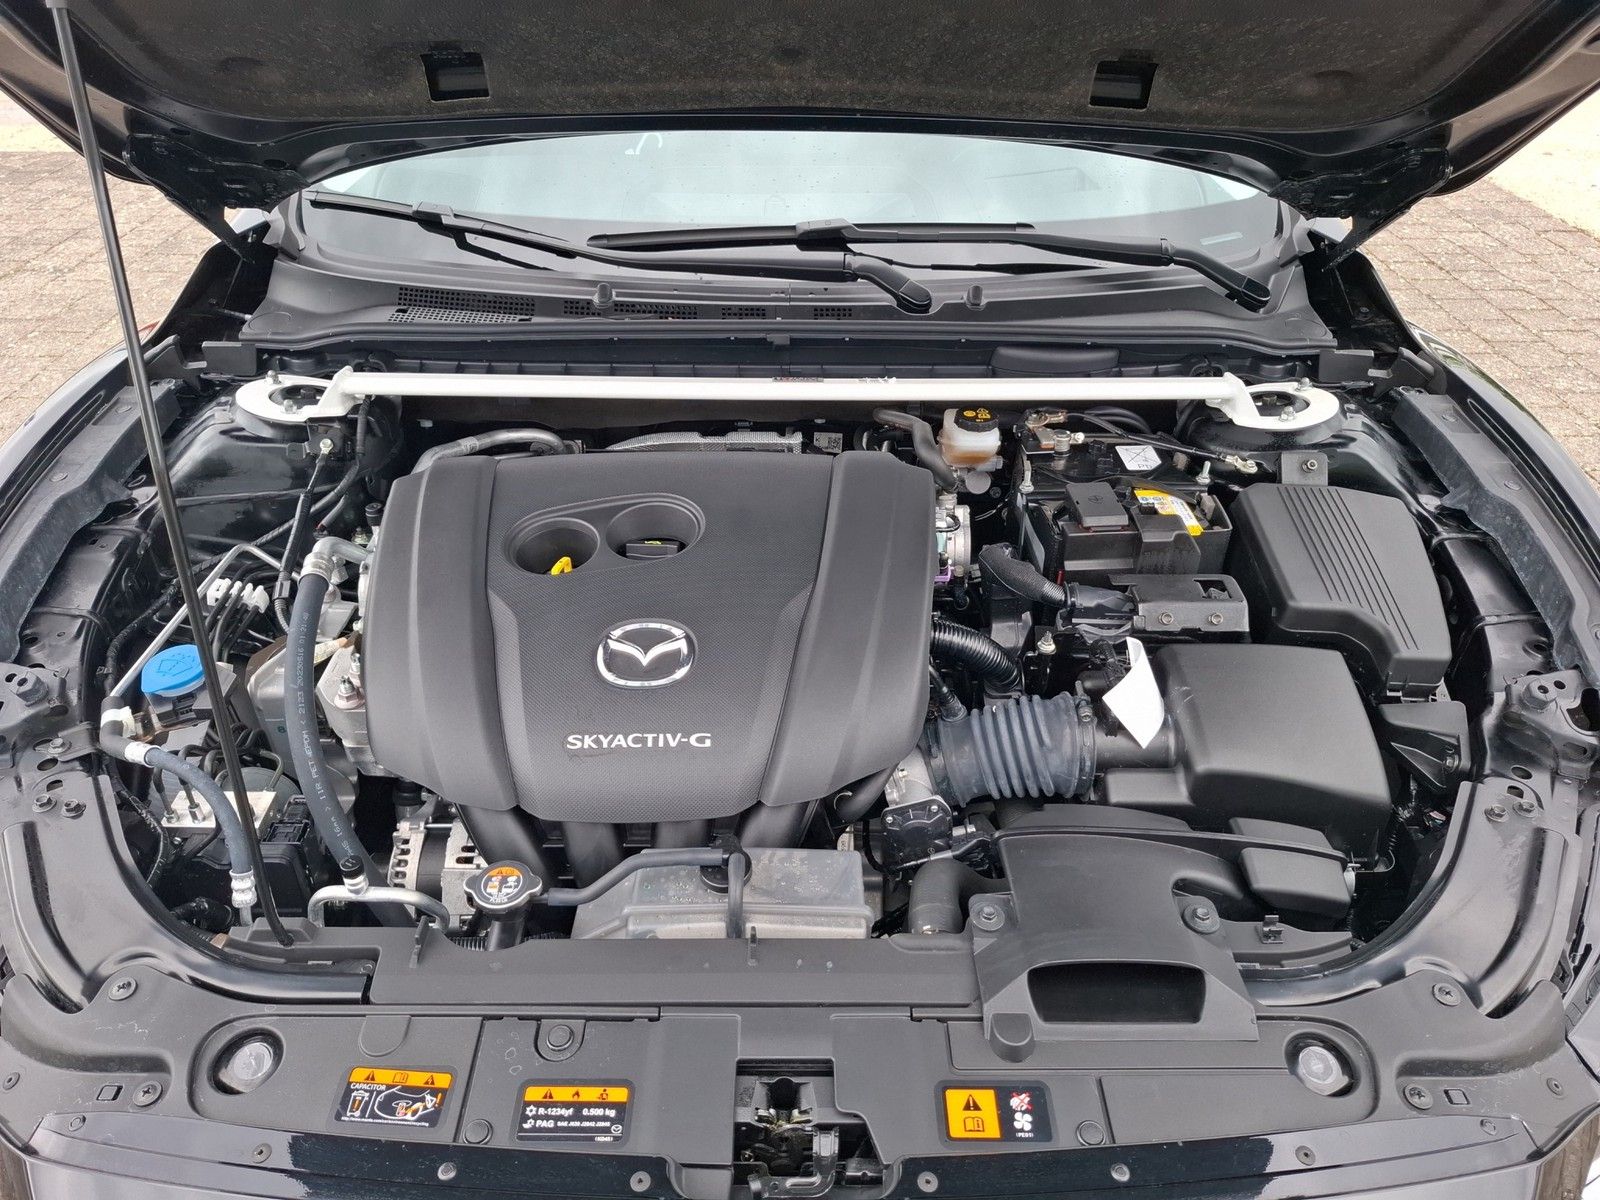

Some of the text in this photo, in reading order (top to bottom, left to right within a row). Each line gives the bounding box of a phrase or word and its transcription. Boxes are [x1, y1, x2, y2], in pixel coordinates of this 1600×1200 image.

[566, 732, 712, 750] SKYACTIV-G
[350, 1082, 387, 1091] CAPACITOR
[537, 1107, 617, 1117] R-1234yf 0.500 kg
[535, 1120, 555, 1128] PAG
